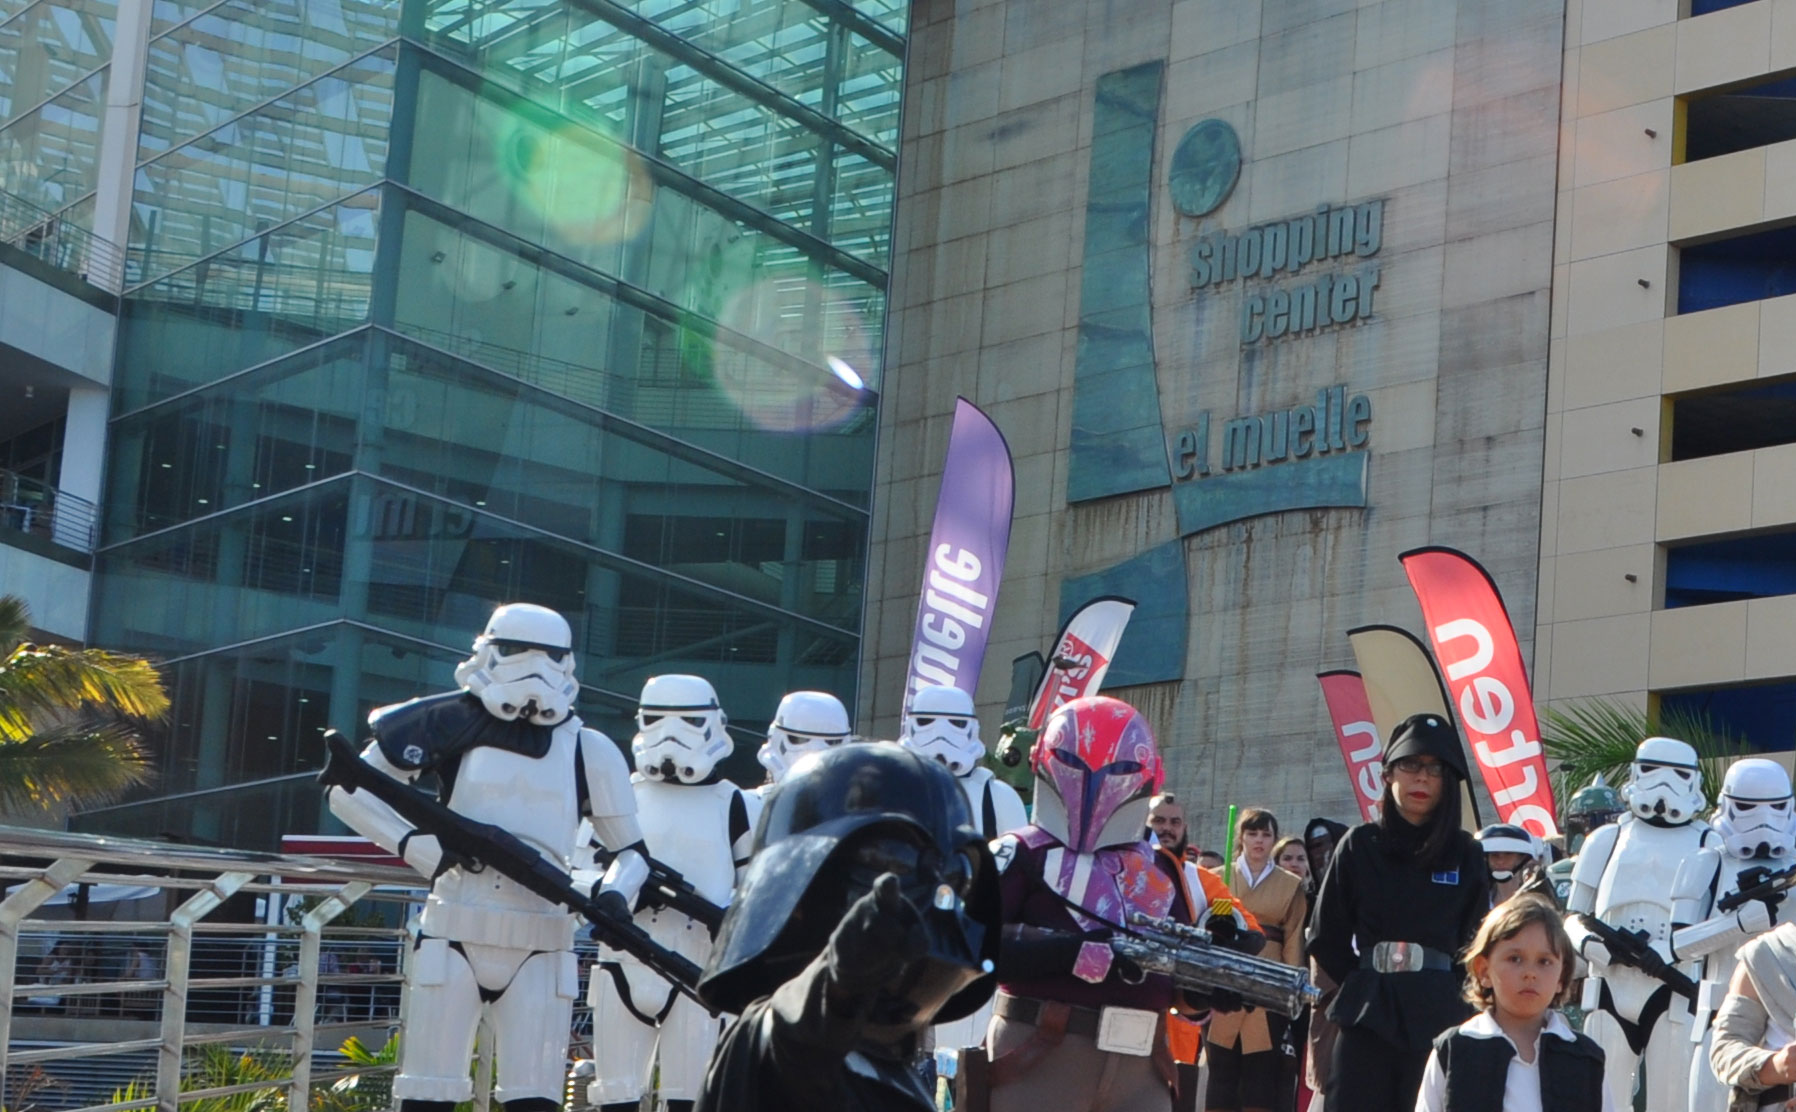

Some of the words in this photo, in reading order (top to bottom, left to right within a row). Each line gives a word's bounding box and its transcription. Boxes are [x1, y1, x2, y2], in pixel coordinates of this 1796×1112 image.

[1240, 267, 1381, 345] center
[1173, 410, 1211, 480] el
[1222, 384, 1372, 471] muelle
